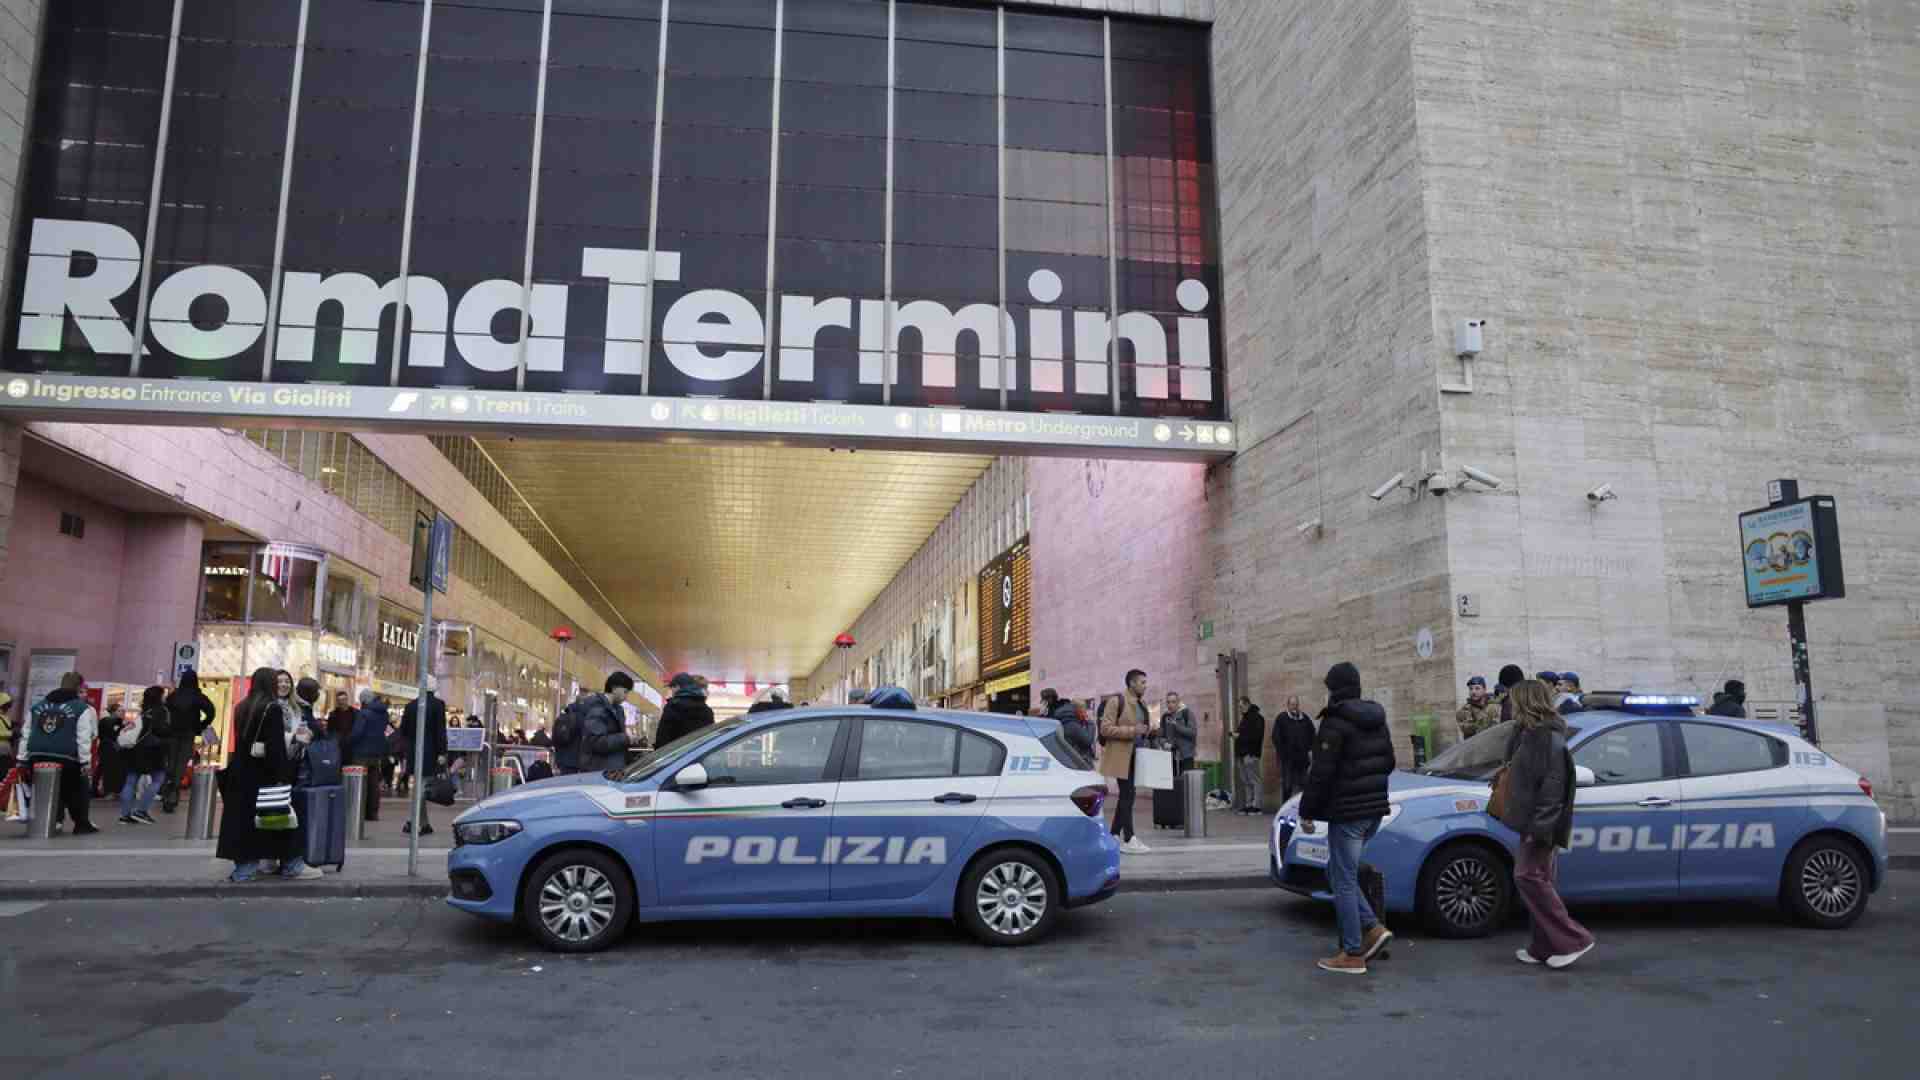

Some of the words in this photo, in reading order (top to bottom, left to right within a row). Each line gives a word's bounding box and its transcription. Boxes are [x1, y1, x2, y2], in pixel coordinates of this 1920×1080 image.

[33, 379, 137, 401] Ingresso
[141, 383, 223, 403] Entrance
[228, 386, 265, 404] Via
[273, 387, 352, 408] Giolitti
[474, 395, 530, 413] Treni
[533, 397, 588, 417] Trains
[721, 403, 807, 426] Biglietti
[809, 406, 865, 426] Tickets
[964, 414, 1026, 433] Metro
[1031, 417, 1138, 440] Underground
[1007, 755, 1051, 772] 113
[1793, 751, 1826, 767] 113
[1568, 822, 1777, 852] POLIZIA
[684, 835, 948, 866] POLIZIA
